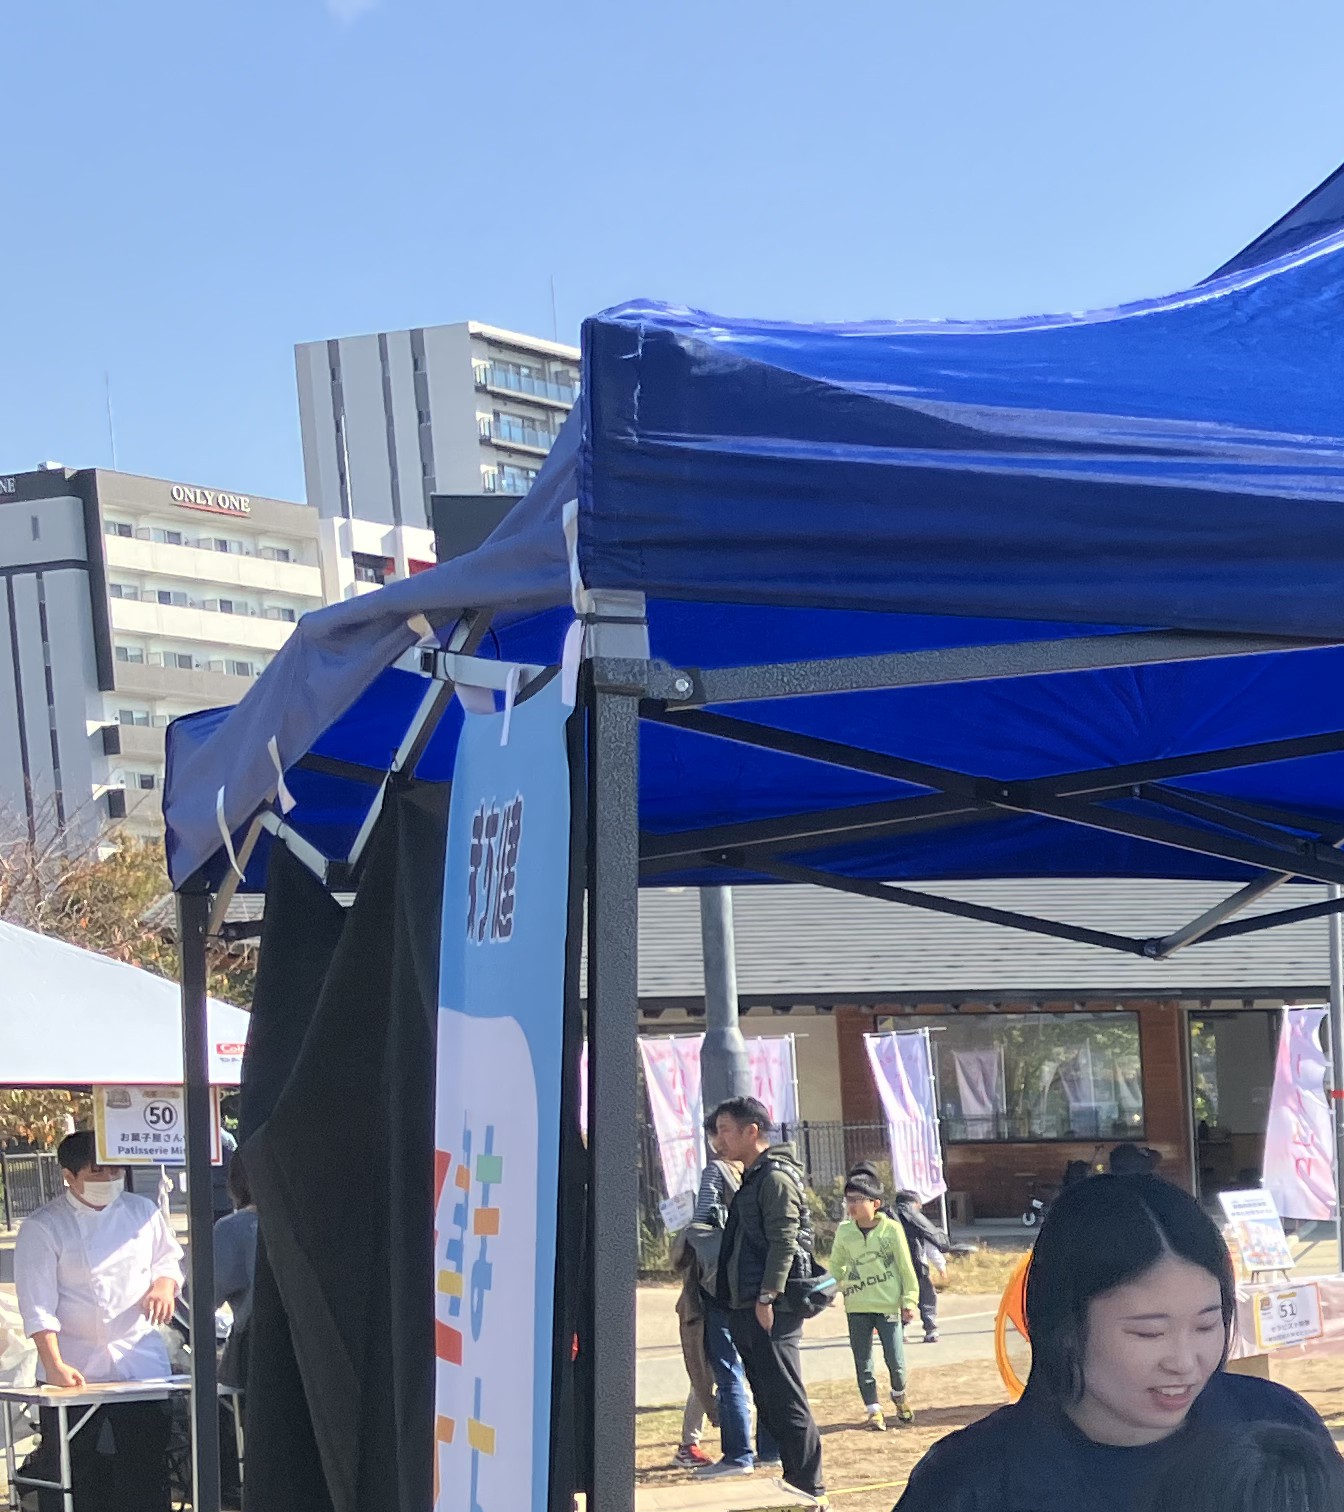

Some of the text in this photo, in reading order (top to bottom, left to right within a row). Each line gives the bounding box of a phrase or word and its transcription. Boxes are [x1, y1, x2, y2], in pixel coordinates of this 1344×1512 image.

[171, 485, 251, 513] ONLY ONE
[149, 1106, 174, 1125] 50
[120, 1132, 185, 1143] お菓子屋さん
[118, 1145, 169, 1155] Patisserie
[1279, 1303, 1297, 1319] 51
